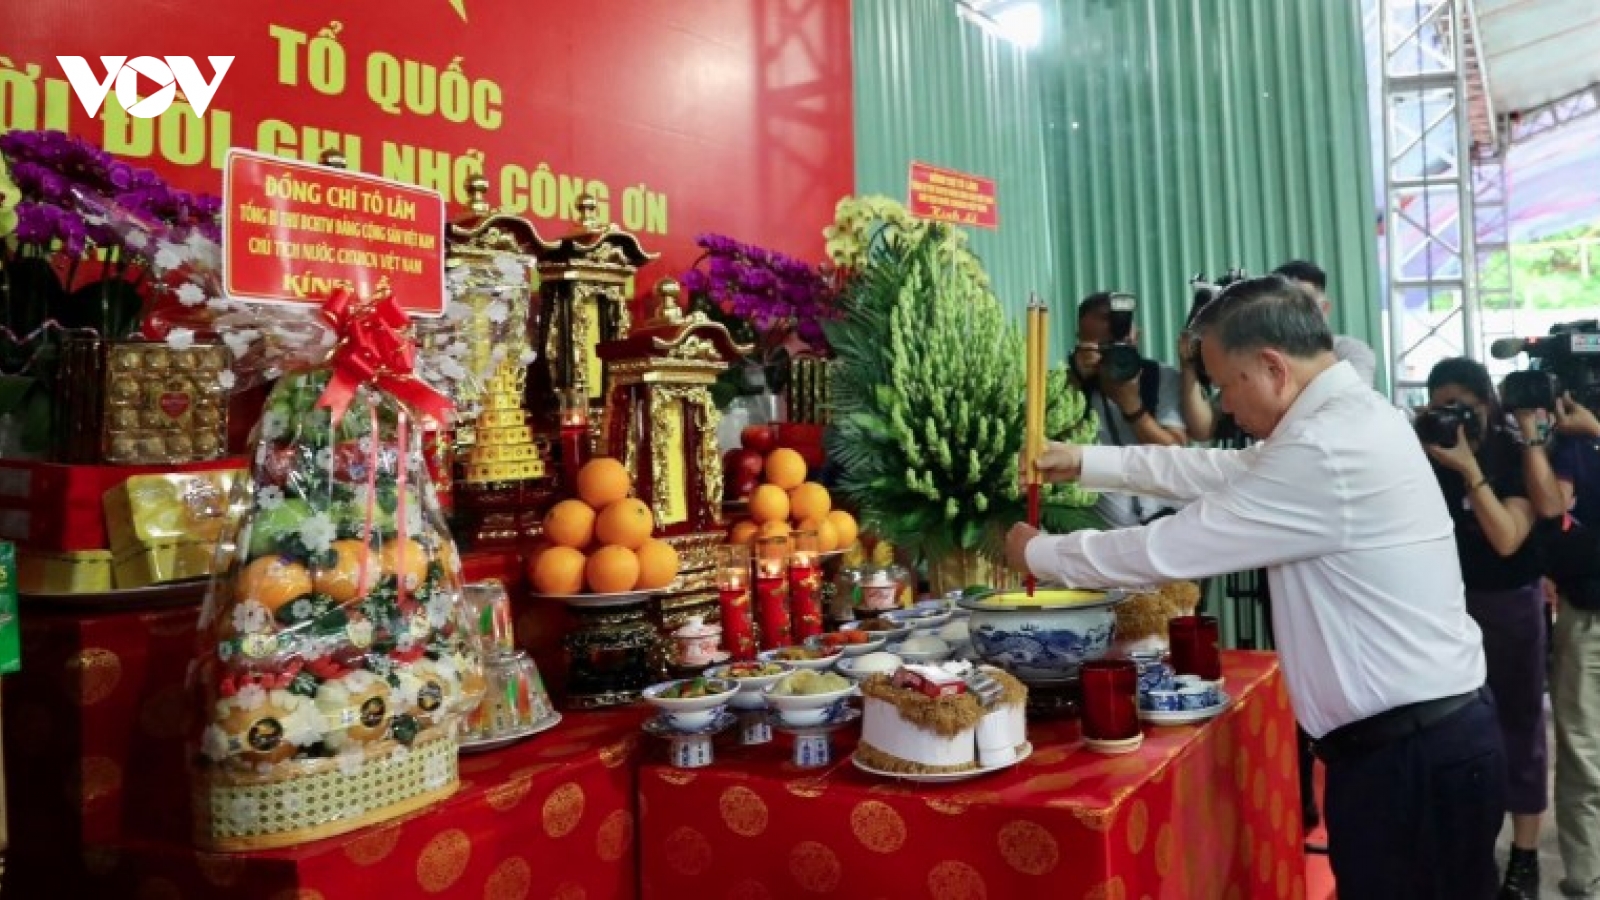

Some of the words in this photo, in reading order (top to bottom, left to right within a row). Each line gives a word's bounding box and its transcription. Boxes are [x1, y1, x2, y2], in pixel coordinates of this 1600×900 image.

[269, 20, 346, 95] TỔ
[366, 51, 502, 130] QUỐC
[265, 172, 321, 204] ĐỒNG
[326, 185, 357, 211] CHÍ
[362, 189, 383, 215] TÔ
[387, 195, 415, 221] LÂM
[500, 162, 610, 225] CÔNG
[622, 183, 668, 235] ƠN
